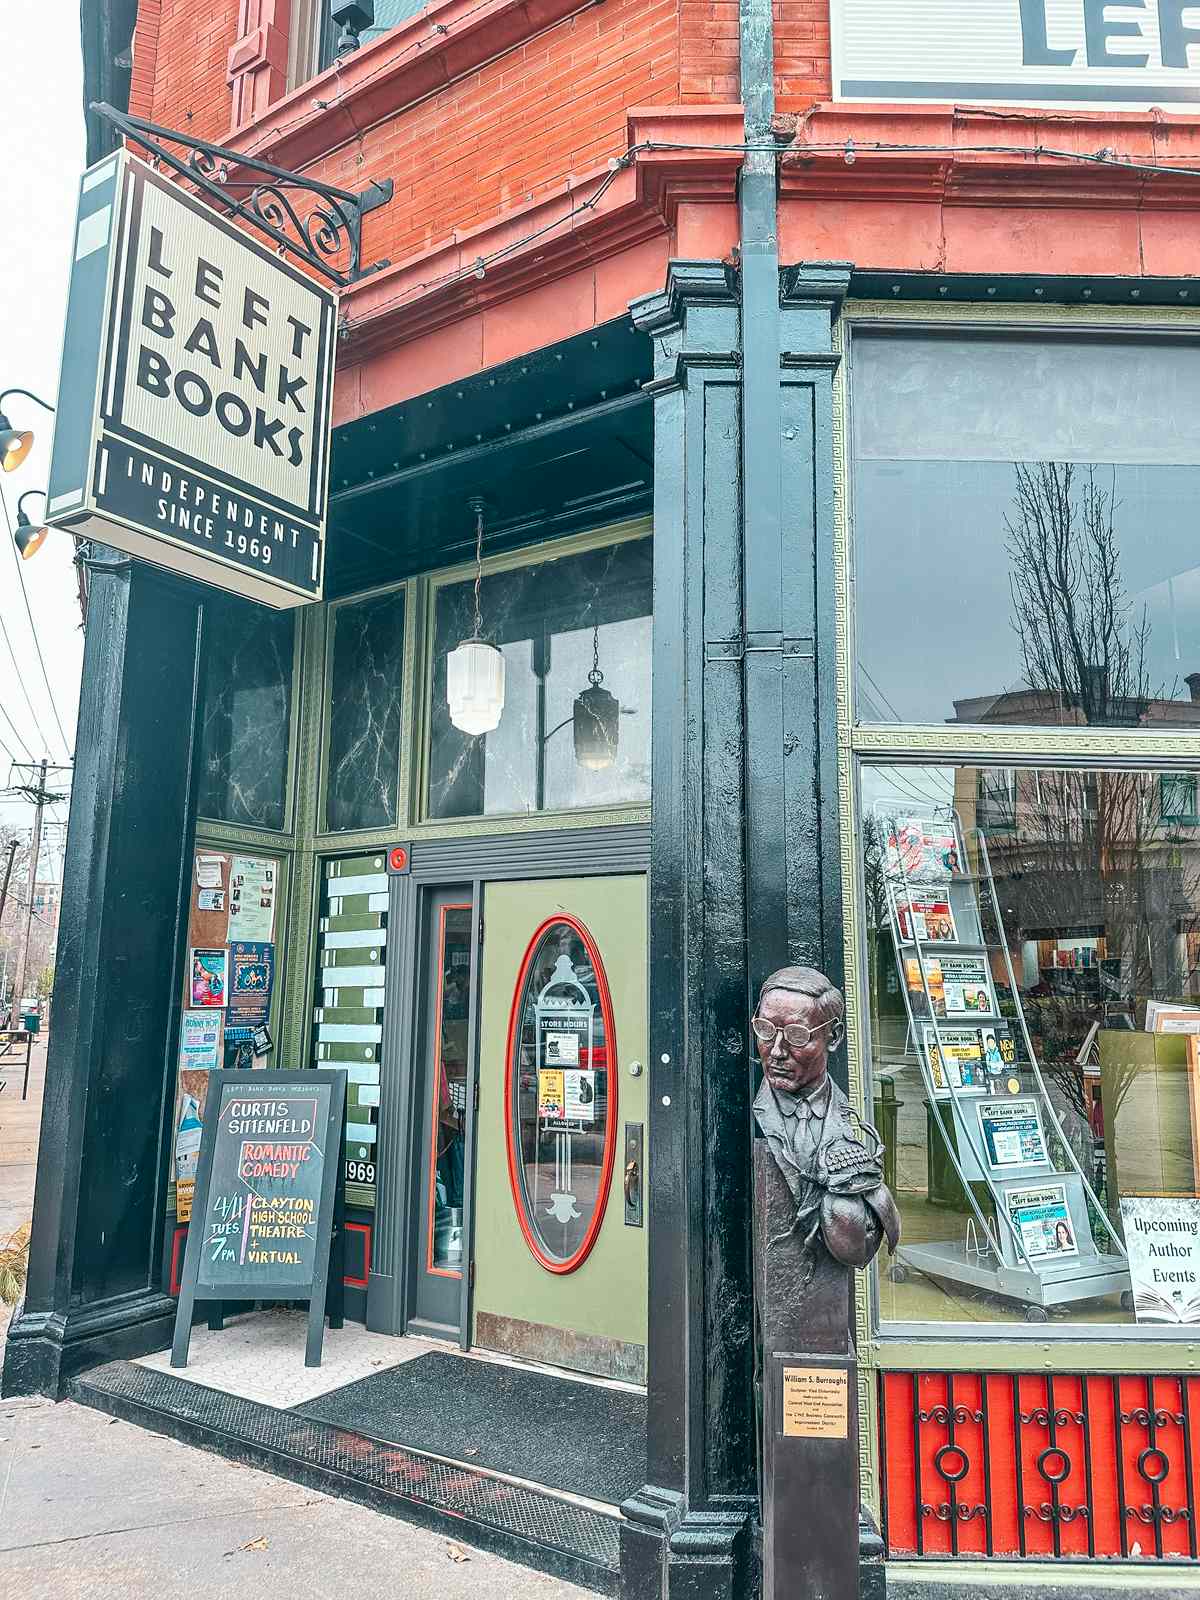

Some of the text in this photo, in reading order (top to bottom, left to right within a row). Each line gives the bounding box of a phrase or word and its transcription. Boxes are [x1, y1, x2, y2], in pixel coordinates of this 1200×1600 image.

[146, 225, 312, 358] LEFT
[141, 284, 307, 413] BANK
[136, 343, 304, 468] BOOKS
[127, 456, 300, 548] INDEPENDENT
[157, 499, 273, 566] SINCE 1969
[231, 1102, 288, 1117] CURTIS
[228, 1119, 310, 1133] SITTENFELD
[244, 1144, 311, 1161] ROMANTIC
[242, 1162, 299, 1178] COMEDY
[345, 1161, 375, 1182] 1969
[214, 1192, 242, 1221] 4/11
[252, 1198, 314, 1212] CLAYTON
[252, 1211, 316, 1224] HIGH SCHOOL
[250, 1225, 306, 1238] THEATRE
[1134, 1218, 1198, 1235] Upcoming
[248, 1251, 302, 1264] VIRTUAL
[1148, 1243, 1192, 1257] Author
[1153, 1269, 1196, 1282] Events
[816, 1376, 846, 1385] Burroughs
